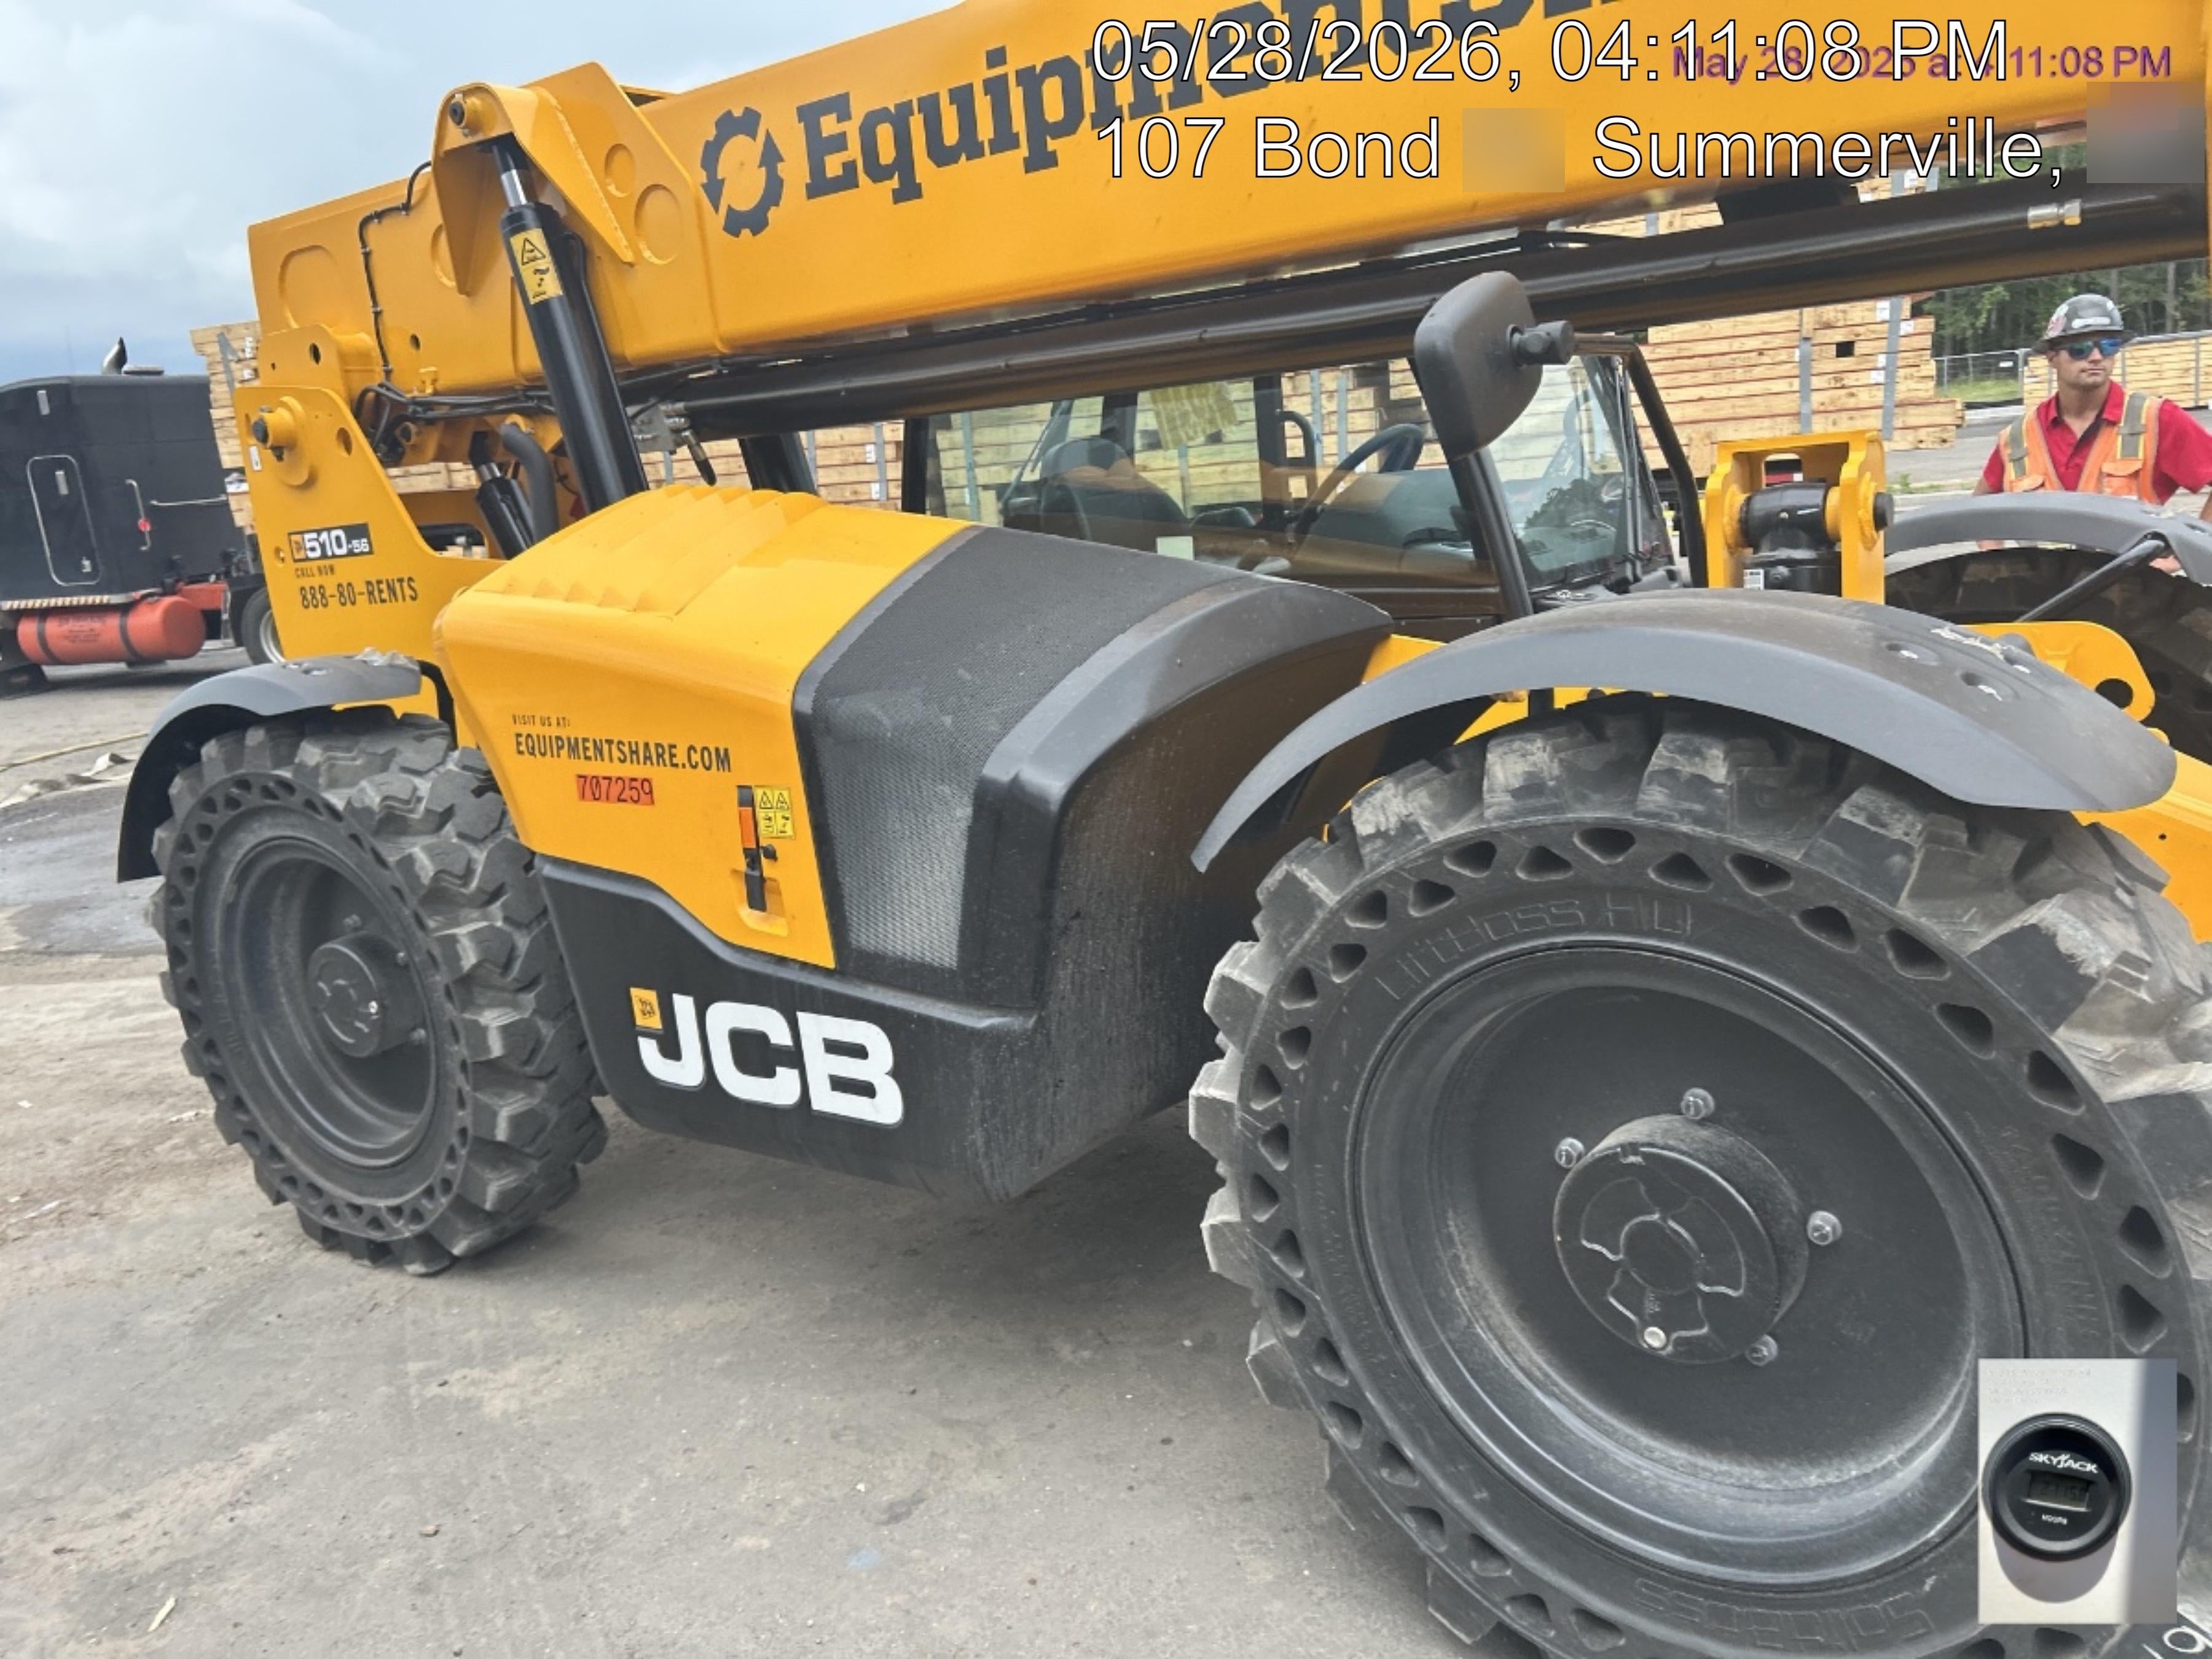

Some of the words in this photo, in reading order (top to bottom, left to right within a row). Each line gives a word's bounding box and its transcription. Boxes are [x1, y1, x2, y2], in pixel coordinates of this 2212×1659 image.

[295, 567, 315, 578] CALL
[317, 564, 335, 576] NOW
[300, 576, 418, 609] 888-80-RENTS
[512, 713, 535, 726] VISIT
[539, 715, 552, 727] US
[515, 732, 732, 773] EQUIPMENTSHARE.COM
[577, 774, 654, 804] 707259
[637, 992, 904, 1127] JCB
